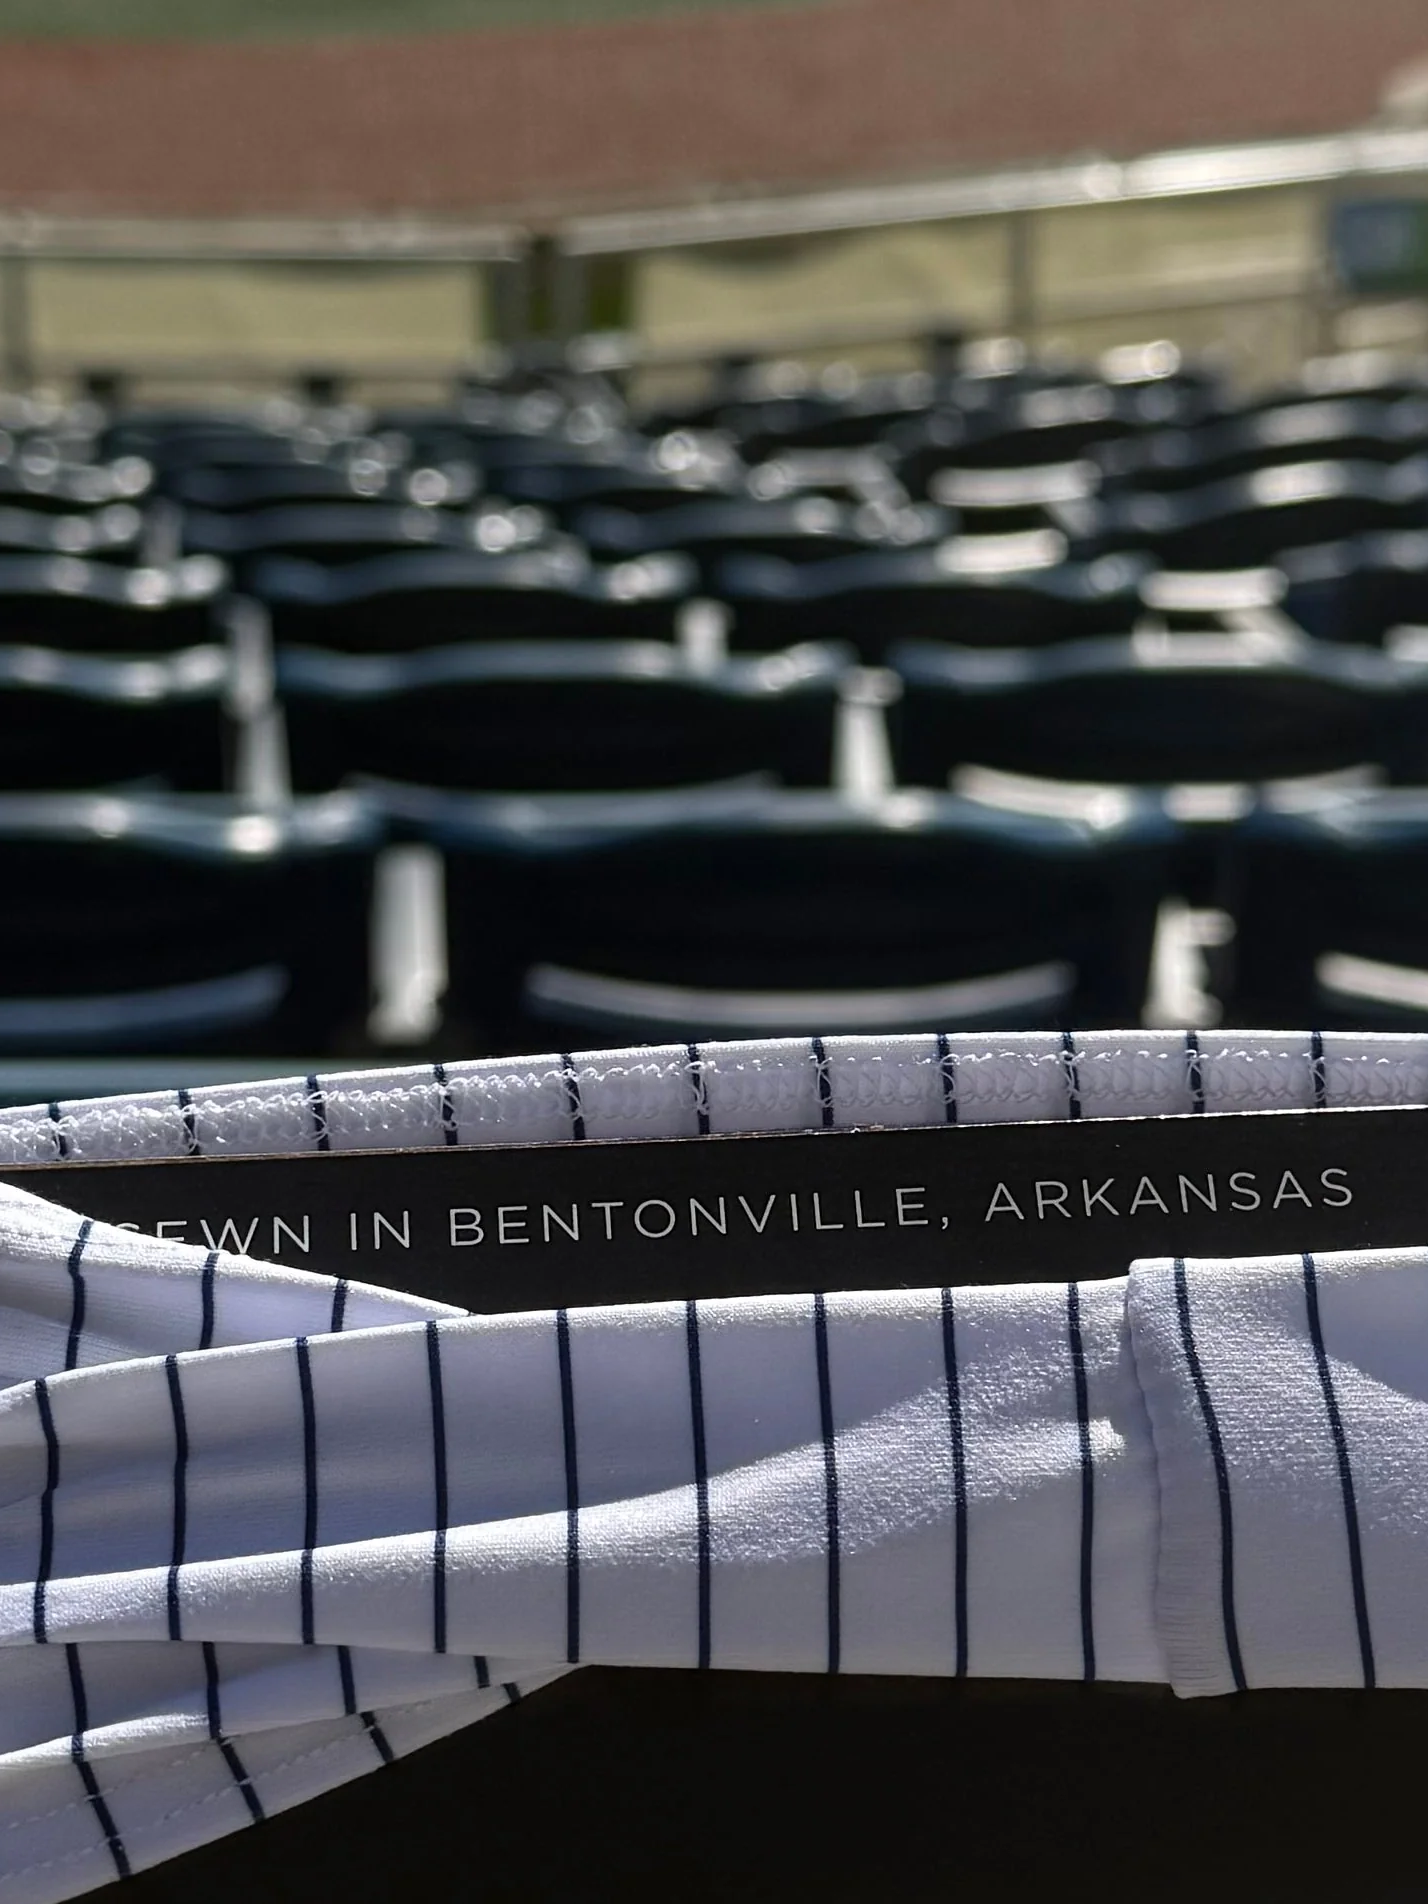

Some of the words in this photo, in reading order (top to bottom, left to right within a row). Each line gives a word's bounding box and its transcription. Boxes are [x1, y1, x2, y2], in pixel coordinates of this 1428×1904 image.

[115, 1213, 311, 1255] EWN
[349, 1210, 411, 1252] IN
[448, 1186, 950, 1248] BENTONVILLE,
[984, 1168, 1354, 1223] ARKANSAS
